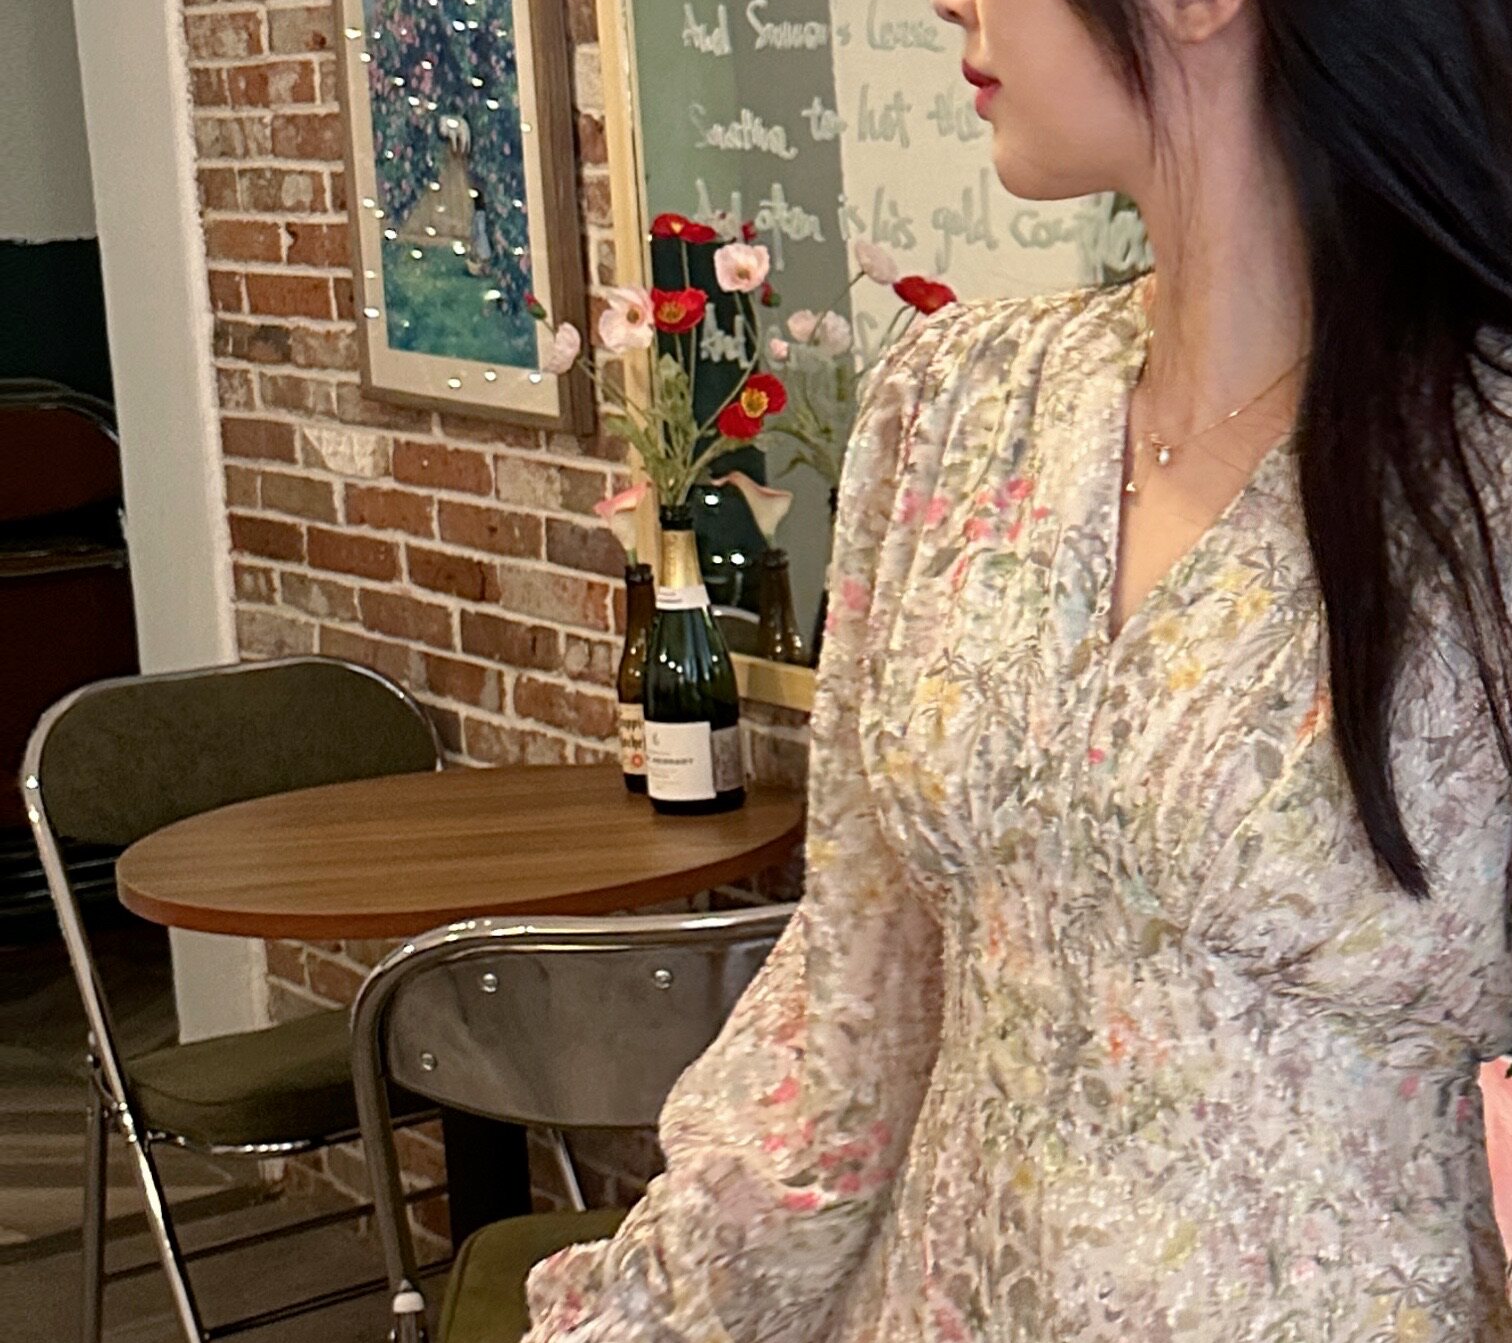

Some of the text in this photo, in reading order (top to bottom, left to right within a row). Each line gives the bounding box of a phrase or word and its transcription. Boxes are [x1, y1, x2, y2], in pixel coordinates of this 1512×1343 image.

[682, 2, 732, 56] And
[857, 83, 911, 149] hot
[872, 186, 918, 250] his
